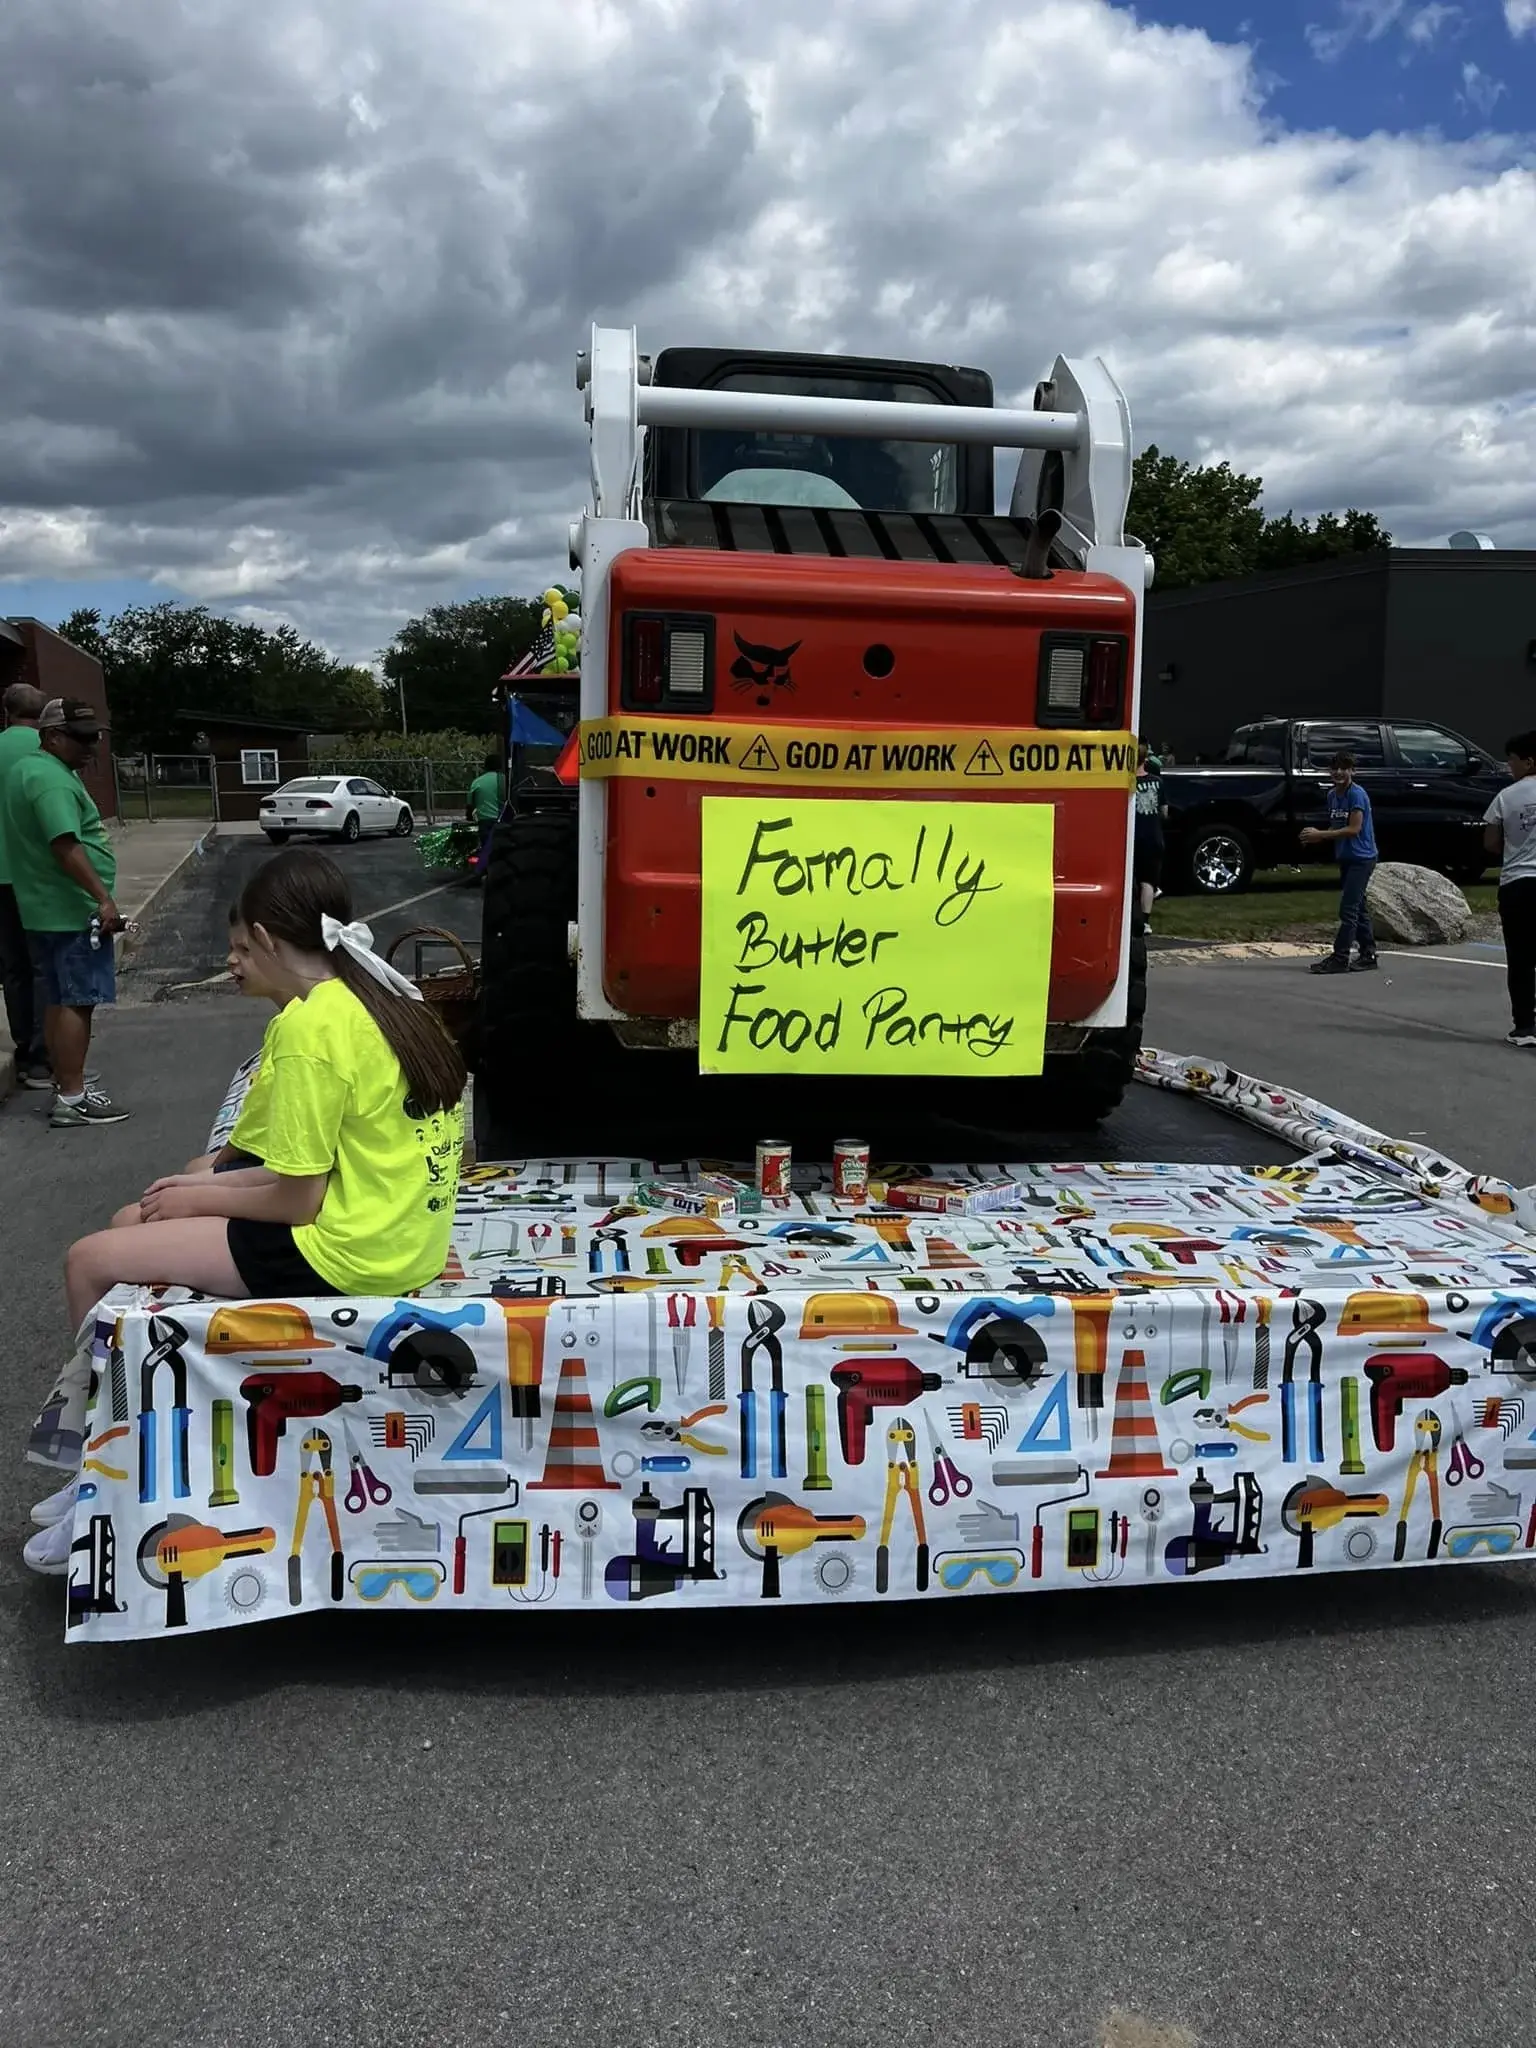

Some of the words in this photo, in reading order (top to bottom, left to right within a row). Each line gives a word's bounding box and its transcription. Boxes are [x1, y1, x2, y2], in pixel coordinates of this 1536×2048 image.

[587, 731, 613, 761] GOD
[615, 730, 646, 759] AT
[652, 732, 731, 765] WORK
[786, 741, 839, 769] GOD
[843, 744, 877, 770] AT
[882, 744, 957, 771] WORK
[1009, 744, 1059, 771] GOD
[1065, 744, 1096, 771] AT
[736, 817, 1003, 926] Formally
[734, 911, 898, 973] Butler
[716, 983, 843, 1053] Food
[862, 986, 1015, 1057] Pantry
[672, 1198, 706, 1214] Aim
